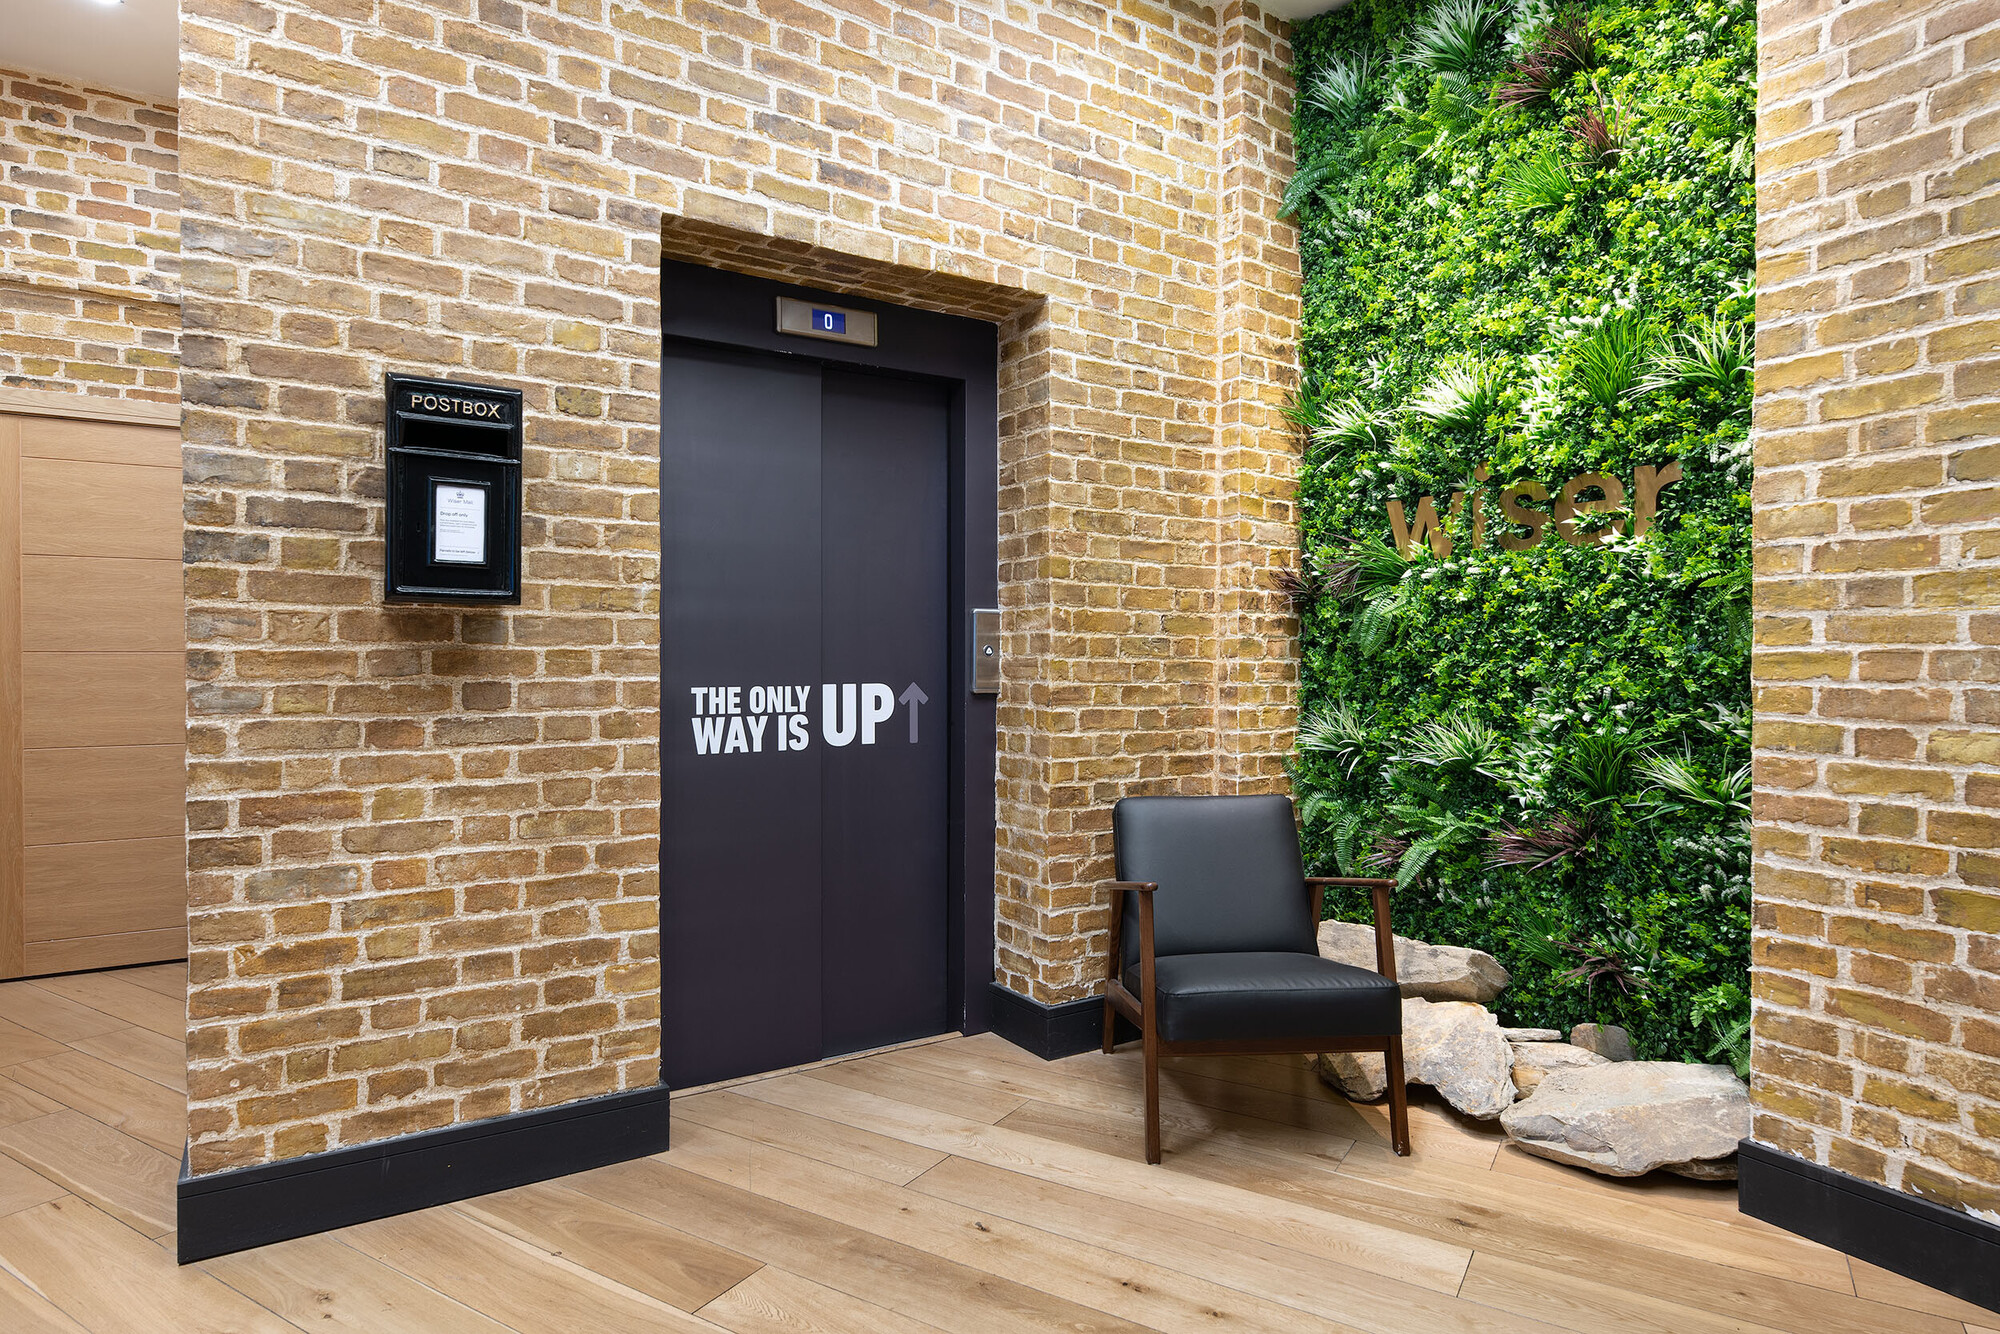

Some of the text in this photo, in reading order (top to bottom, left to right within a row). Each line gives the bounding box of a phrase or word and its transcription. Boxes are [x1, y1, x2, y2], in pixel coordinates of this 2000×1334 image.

[824, 313, 833, 330] 0
[411, 394, 501, 419] POSTBOX
[1385, 461, 1683, 562] wiser
[690, 685, 811, 716] THE ONLY
[822, 682, 896, 747] UP
[691, 714, 810, 755] WAY IS
